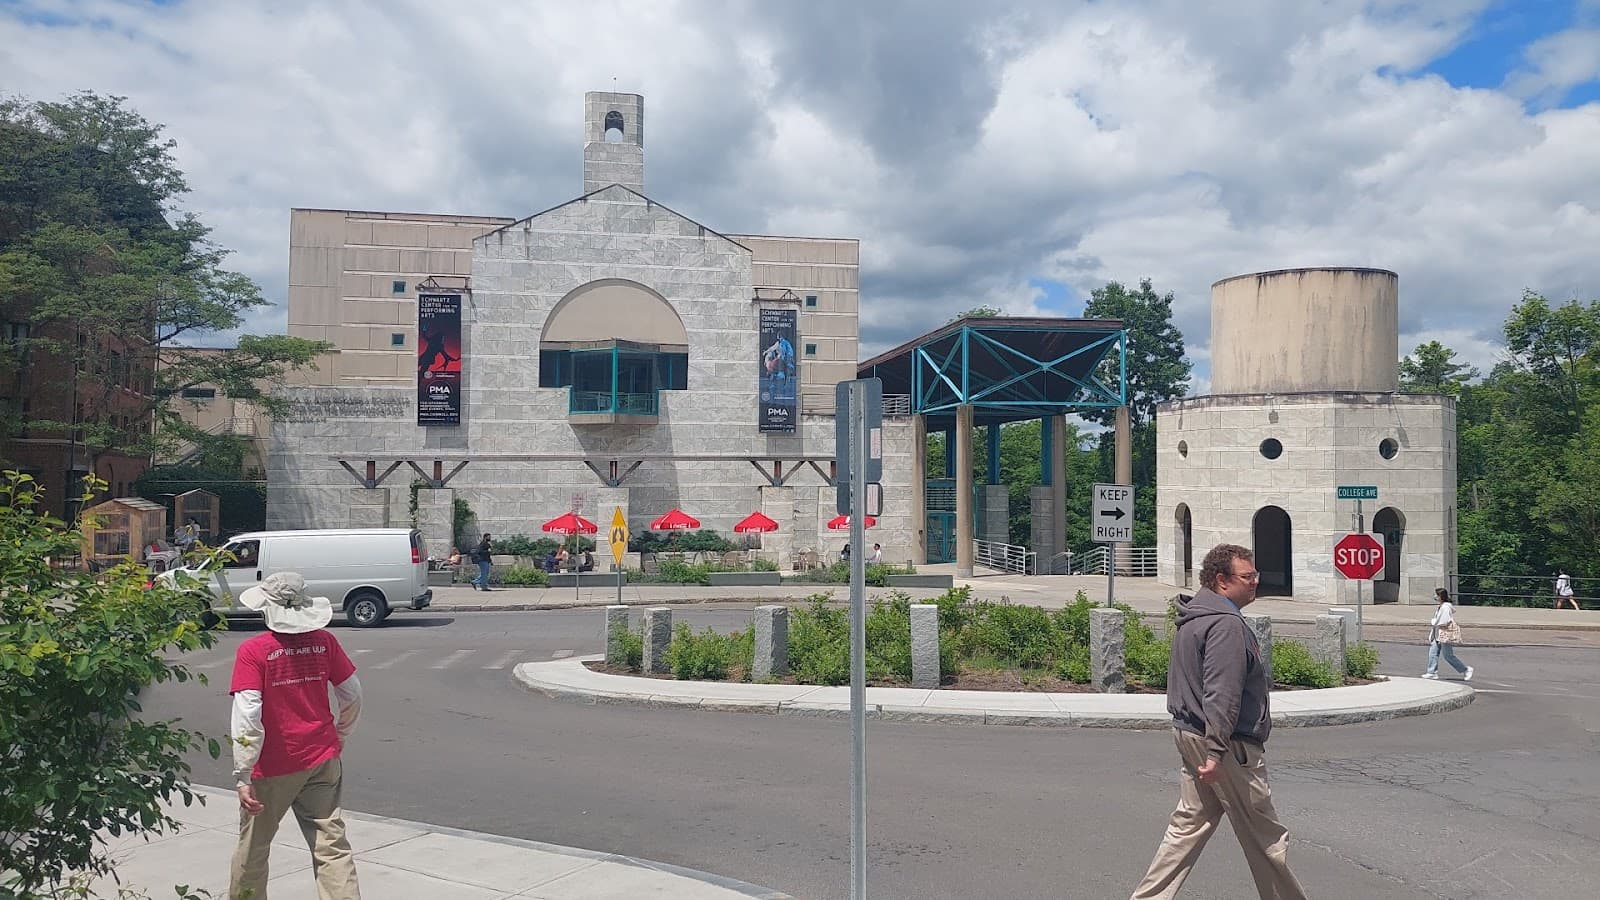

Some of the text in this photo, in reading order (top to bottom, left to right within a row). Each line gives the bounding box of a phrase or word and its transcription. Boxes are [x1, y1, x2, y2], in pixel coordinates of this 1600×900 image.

[430, 386, 450, 394] PMA
[767, 408, 788, 416] PMA
[1100, 489, 1128, 501] KEEP
[1338, 488, 1377, 497] COLLEGE AVE
[1097, 526, 1130, 538] RIGHT
[1337, 548, 1380, 566] STOP
